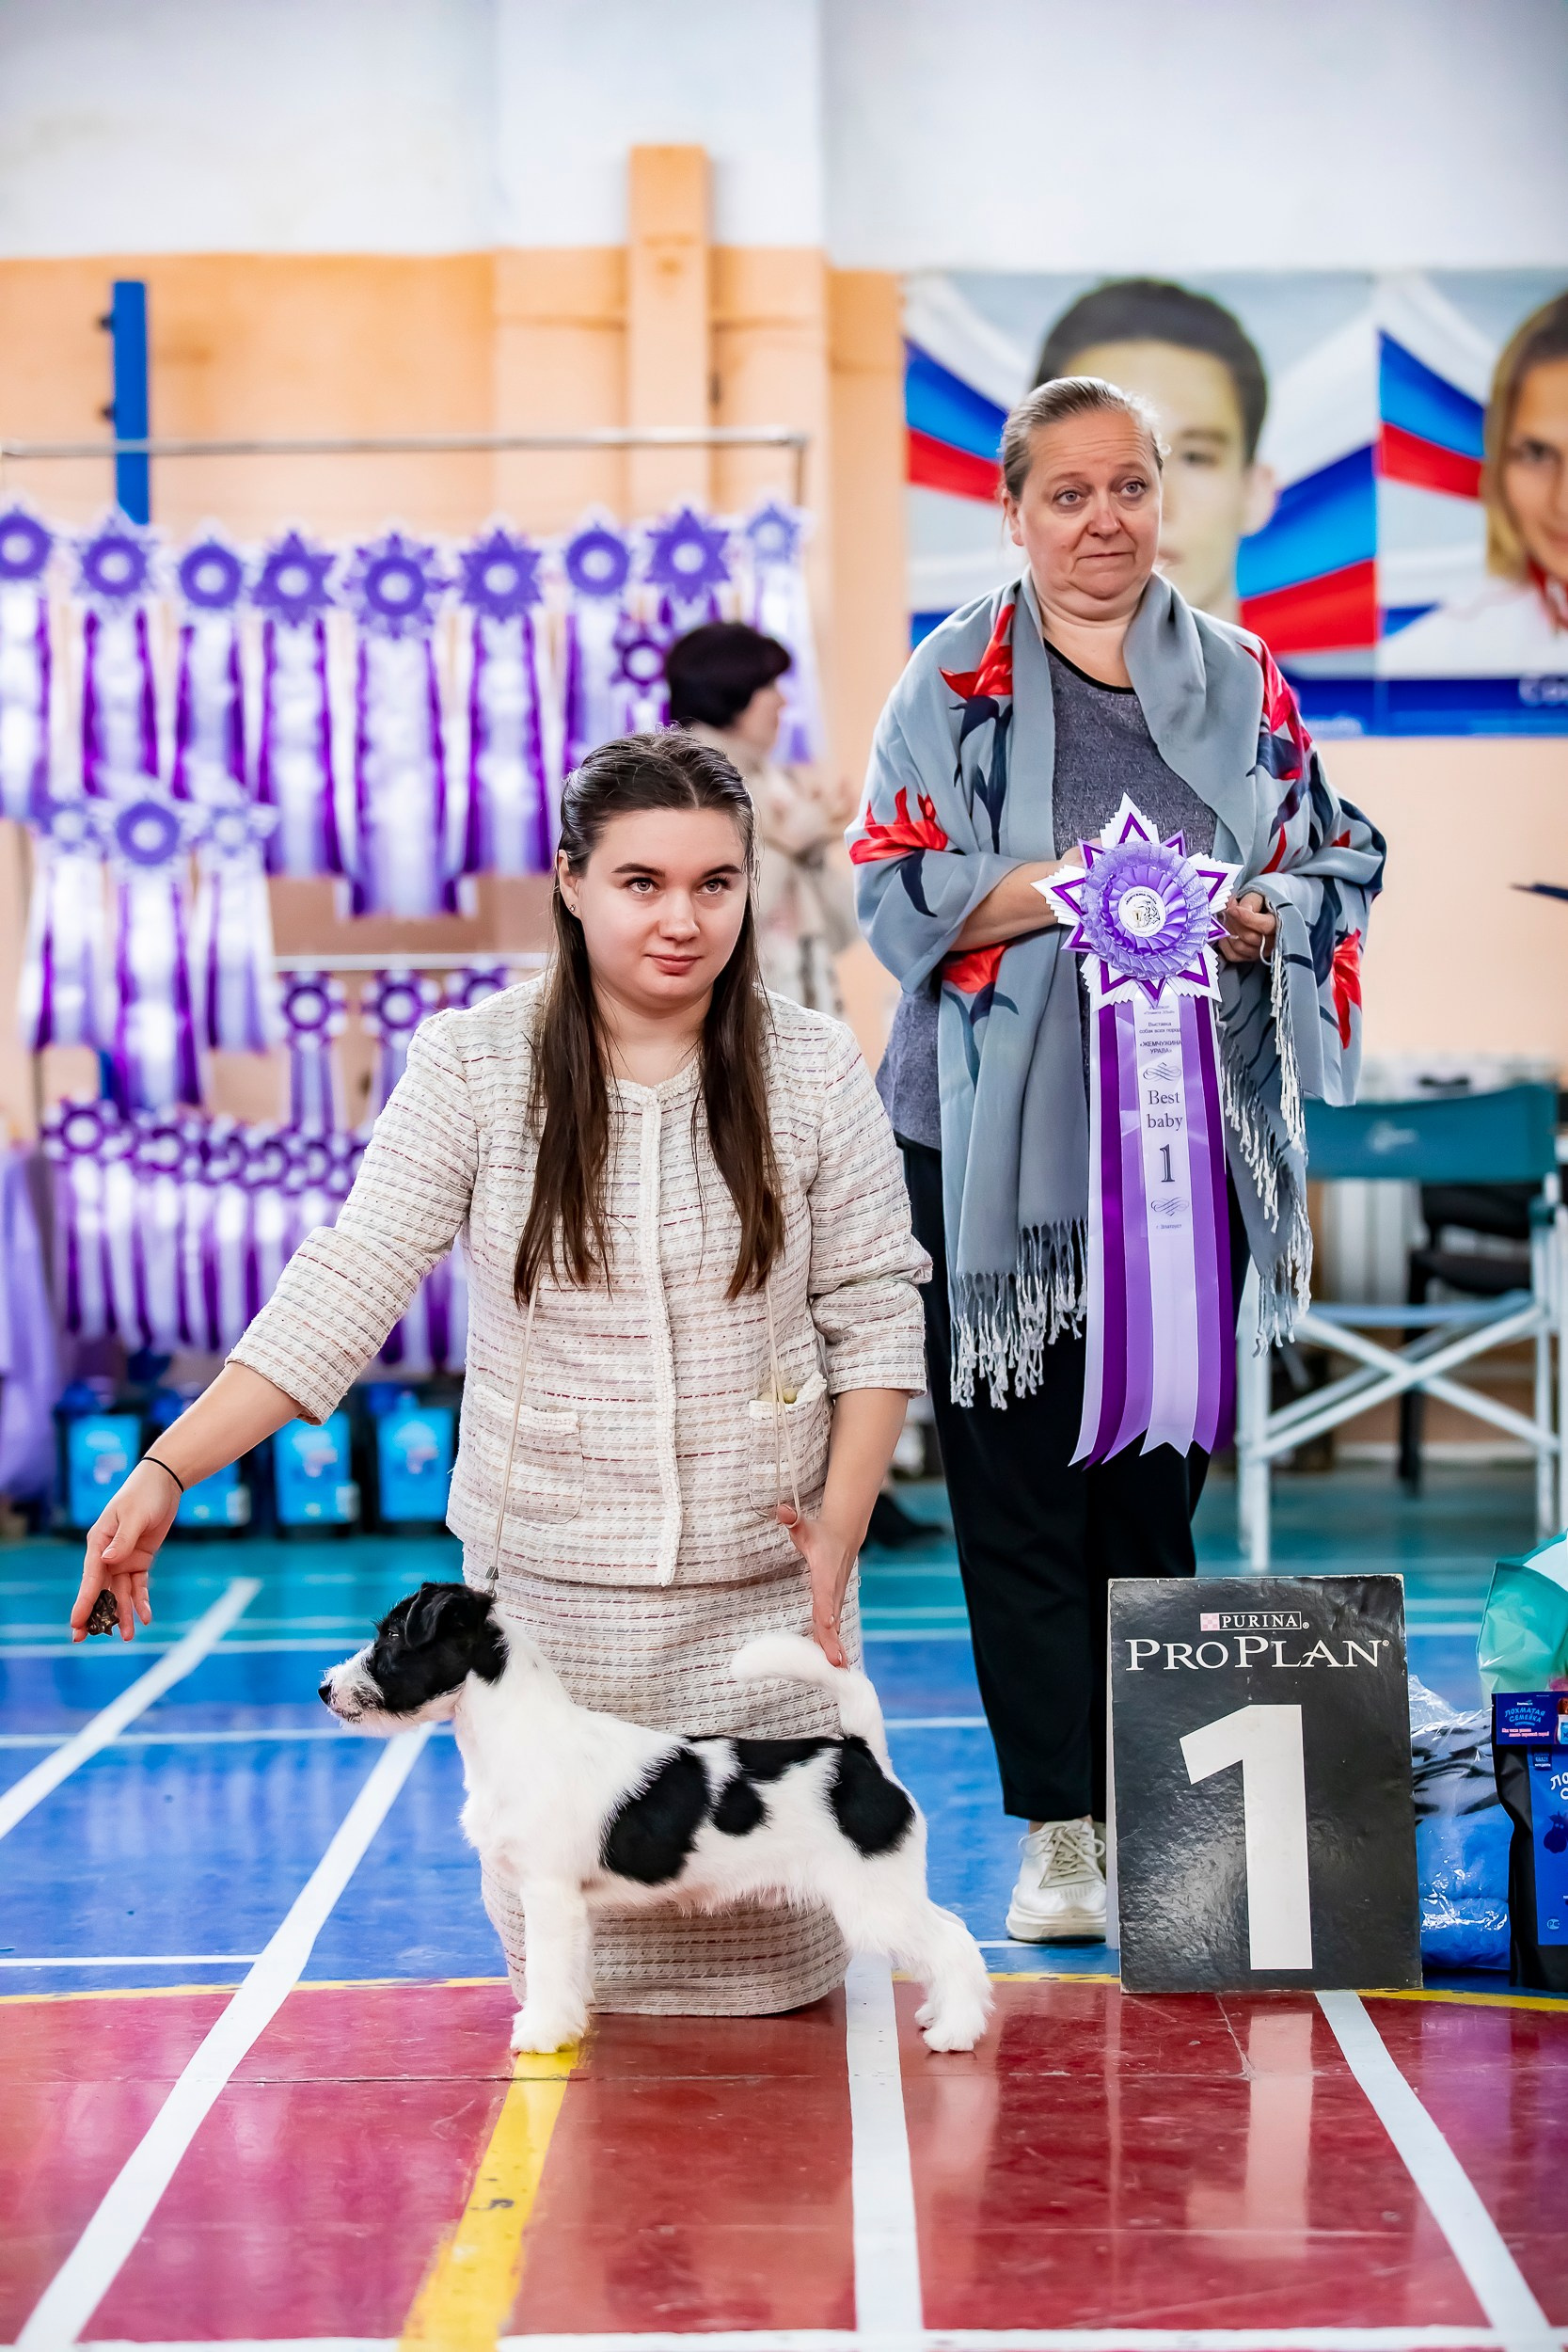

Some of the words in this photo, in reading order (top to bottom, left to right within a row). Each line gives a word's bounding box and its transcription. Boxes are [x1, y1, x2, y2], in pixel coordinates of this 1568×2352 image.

[1147, 1089, 1180, 1105] Best
[1147, 1112, 1183, 1132] baby
[1159, 1143, 1176, 1183] 1
[1221, 1613, 1299, 1629] PURINA
[1504, 1706, 1546, 1718] ЛОХМАТАЯ
[1509, 1713, 1542, 1724] СЕМЕЙКА
[1179, 1703, 1313, 1971] 1
